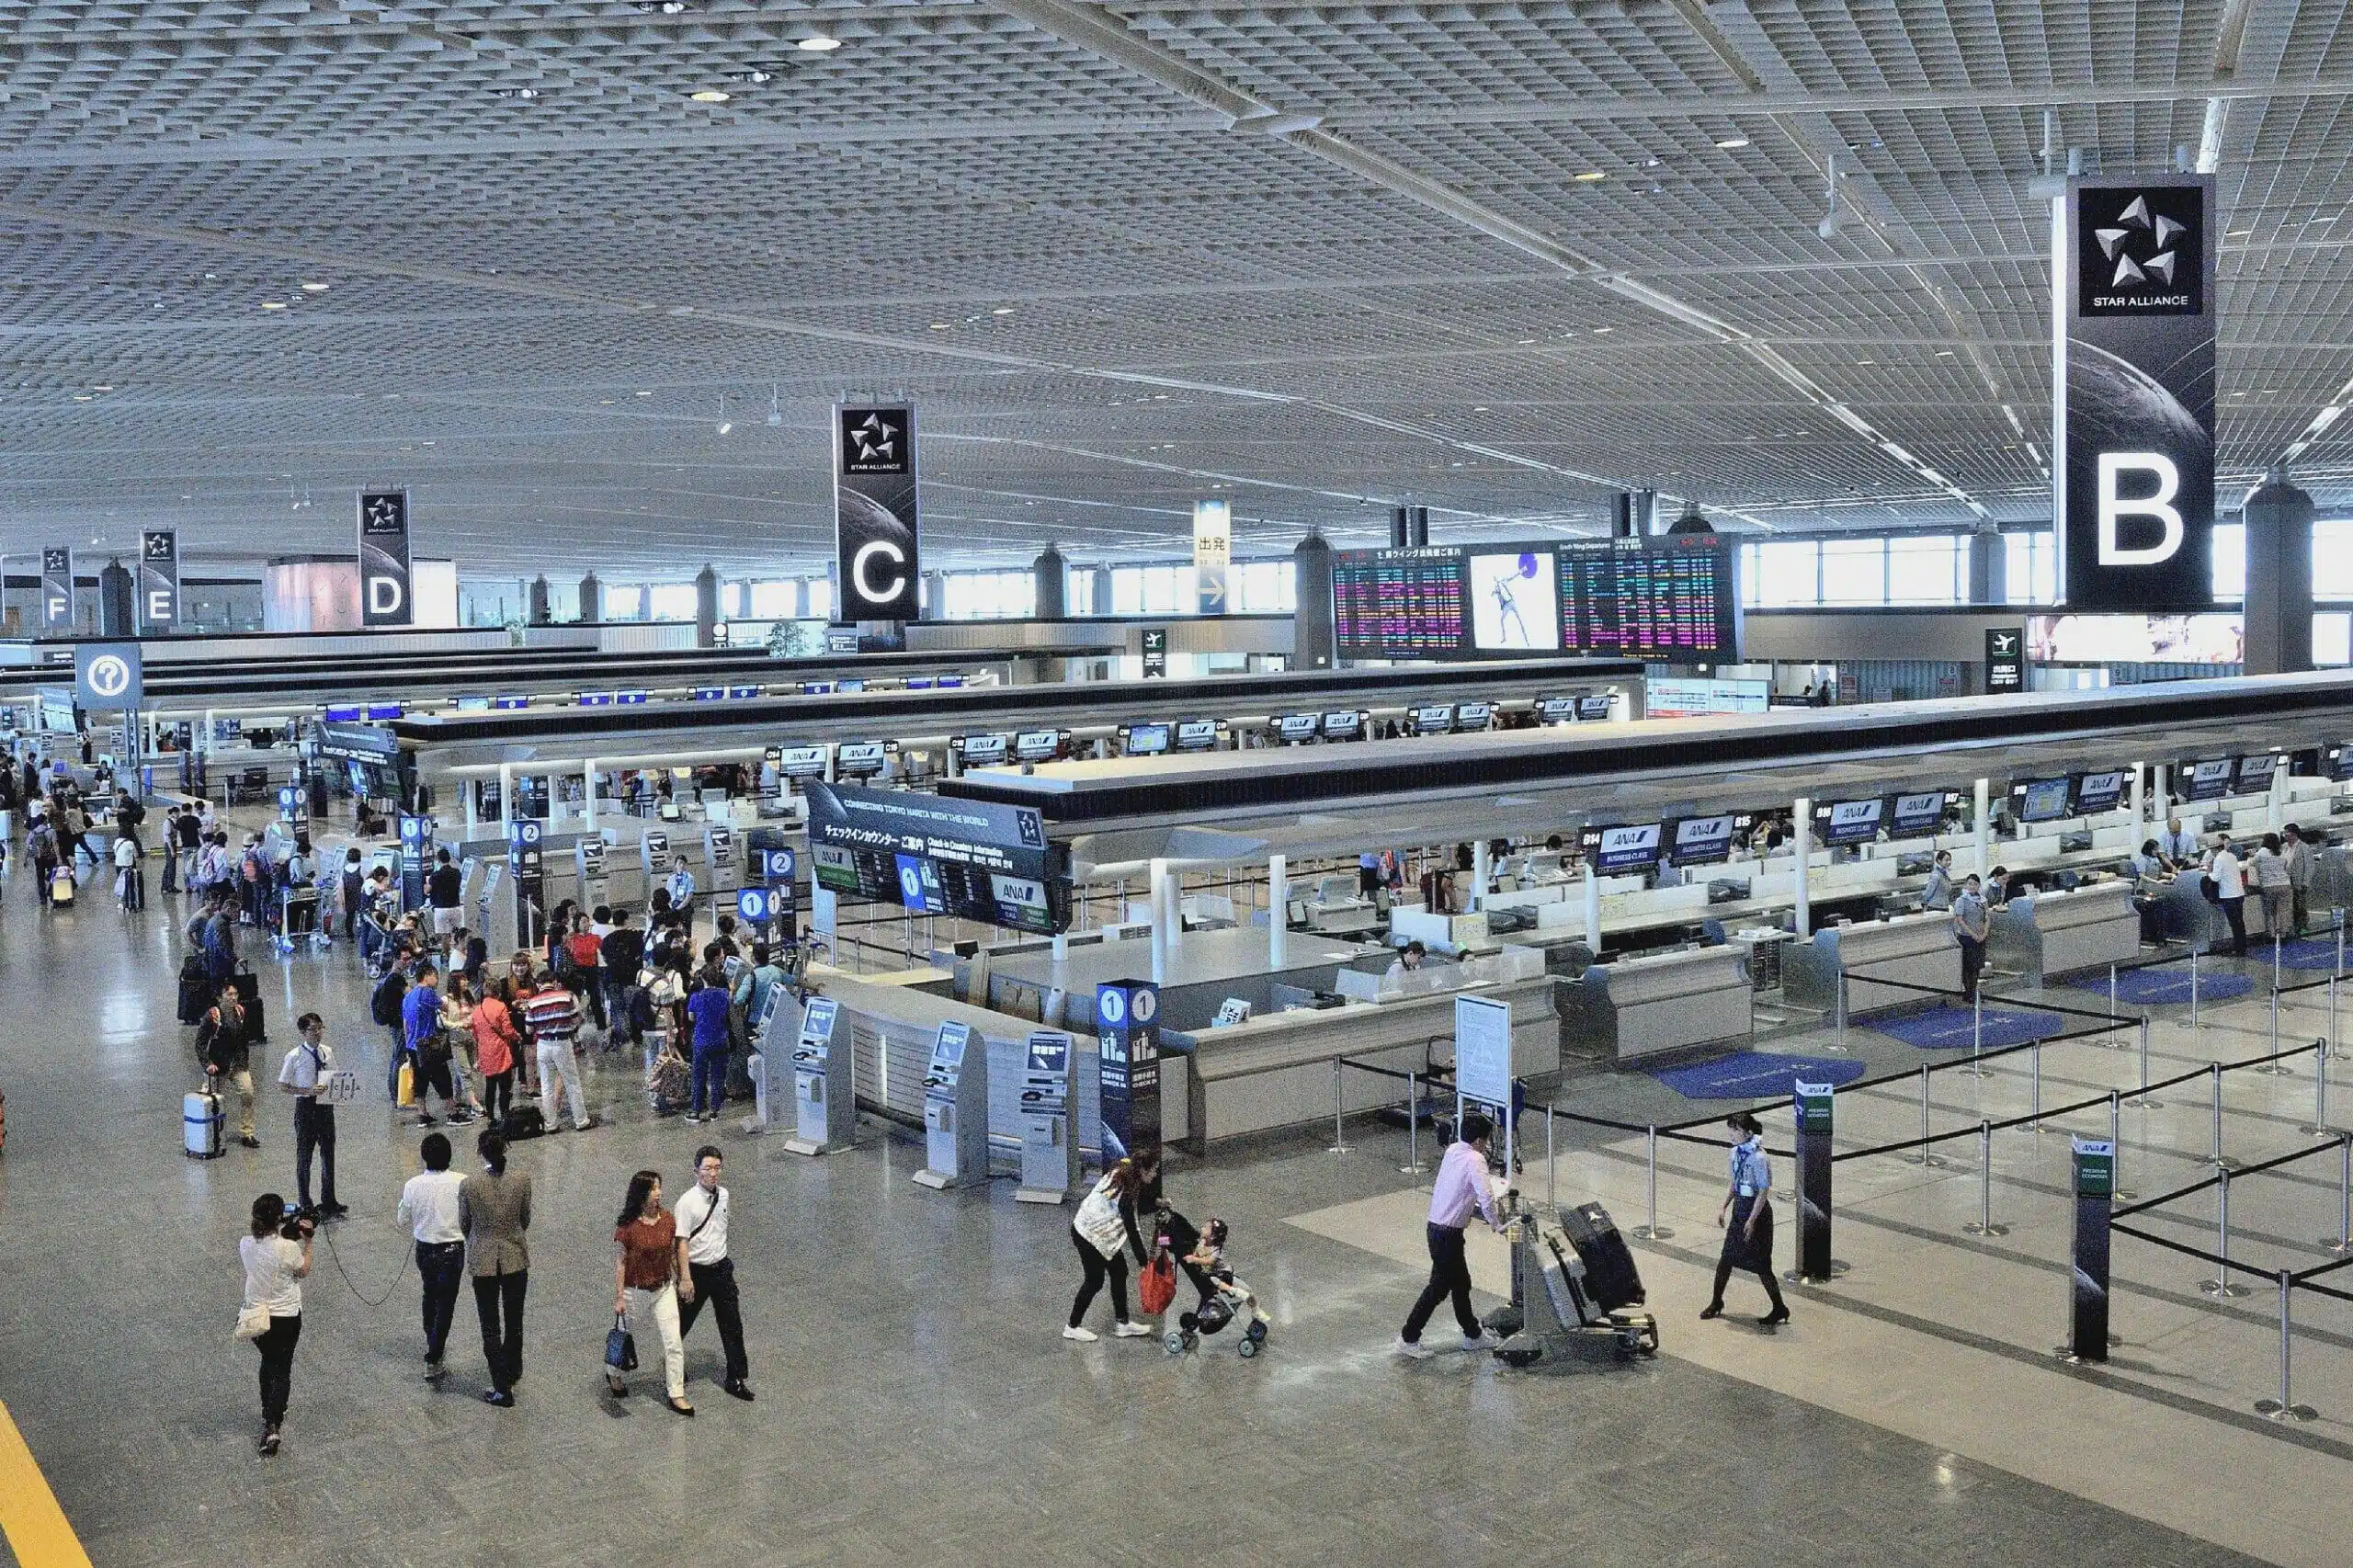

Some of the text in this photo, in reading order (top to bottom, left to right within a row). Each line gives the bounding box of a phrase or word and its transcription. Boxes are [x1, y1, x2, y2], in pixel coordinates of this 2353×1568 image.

[2094, 296, 2188, 306] STAR ALLIANCE
[2098, 452, 2184, 566] B
[1199, 537, 1225, 551] 出発
[853, 540, 905, 603] C
[369, 576, 402, 614] D
[50, 598, 66, 621] F
[150, 591, 172, 619] E
[1842, 806, 1861, 818] ANA
[1906, 798, 1925, 812] ANA
[844, 799, 989, 826] CONNECTING TOKYO NARITA WITH THE WORLD
[1734, 816, 1752, 827] B15
[527, 827, 534, 838] 2
[824, 824, 899, 846] チェックインカウンター
[1688, 824, 1710, 837] ANA
[927, 836, 949, 849] Check-in
[1583, 833, 1600, 846] B14
[1612, 832, 1636, 846] ANA
[1682, 842, 1722, 854] BUSINESS CLASS
[777, 856, 786, 869] 2
[1607, 851, 1648, 862] BUSINESS CLASS
[1004, 884, 1024, 900] ANA
[747, 896, 755, 912] 1
[1108, 995, 1115, 1017] 1
[1140, 994, 1146, 1016] 1
[1131, 1079, 1151, 1088] CHECK
